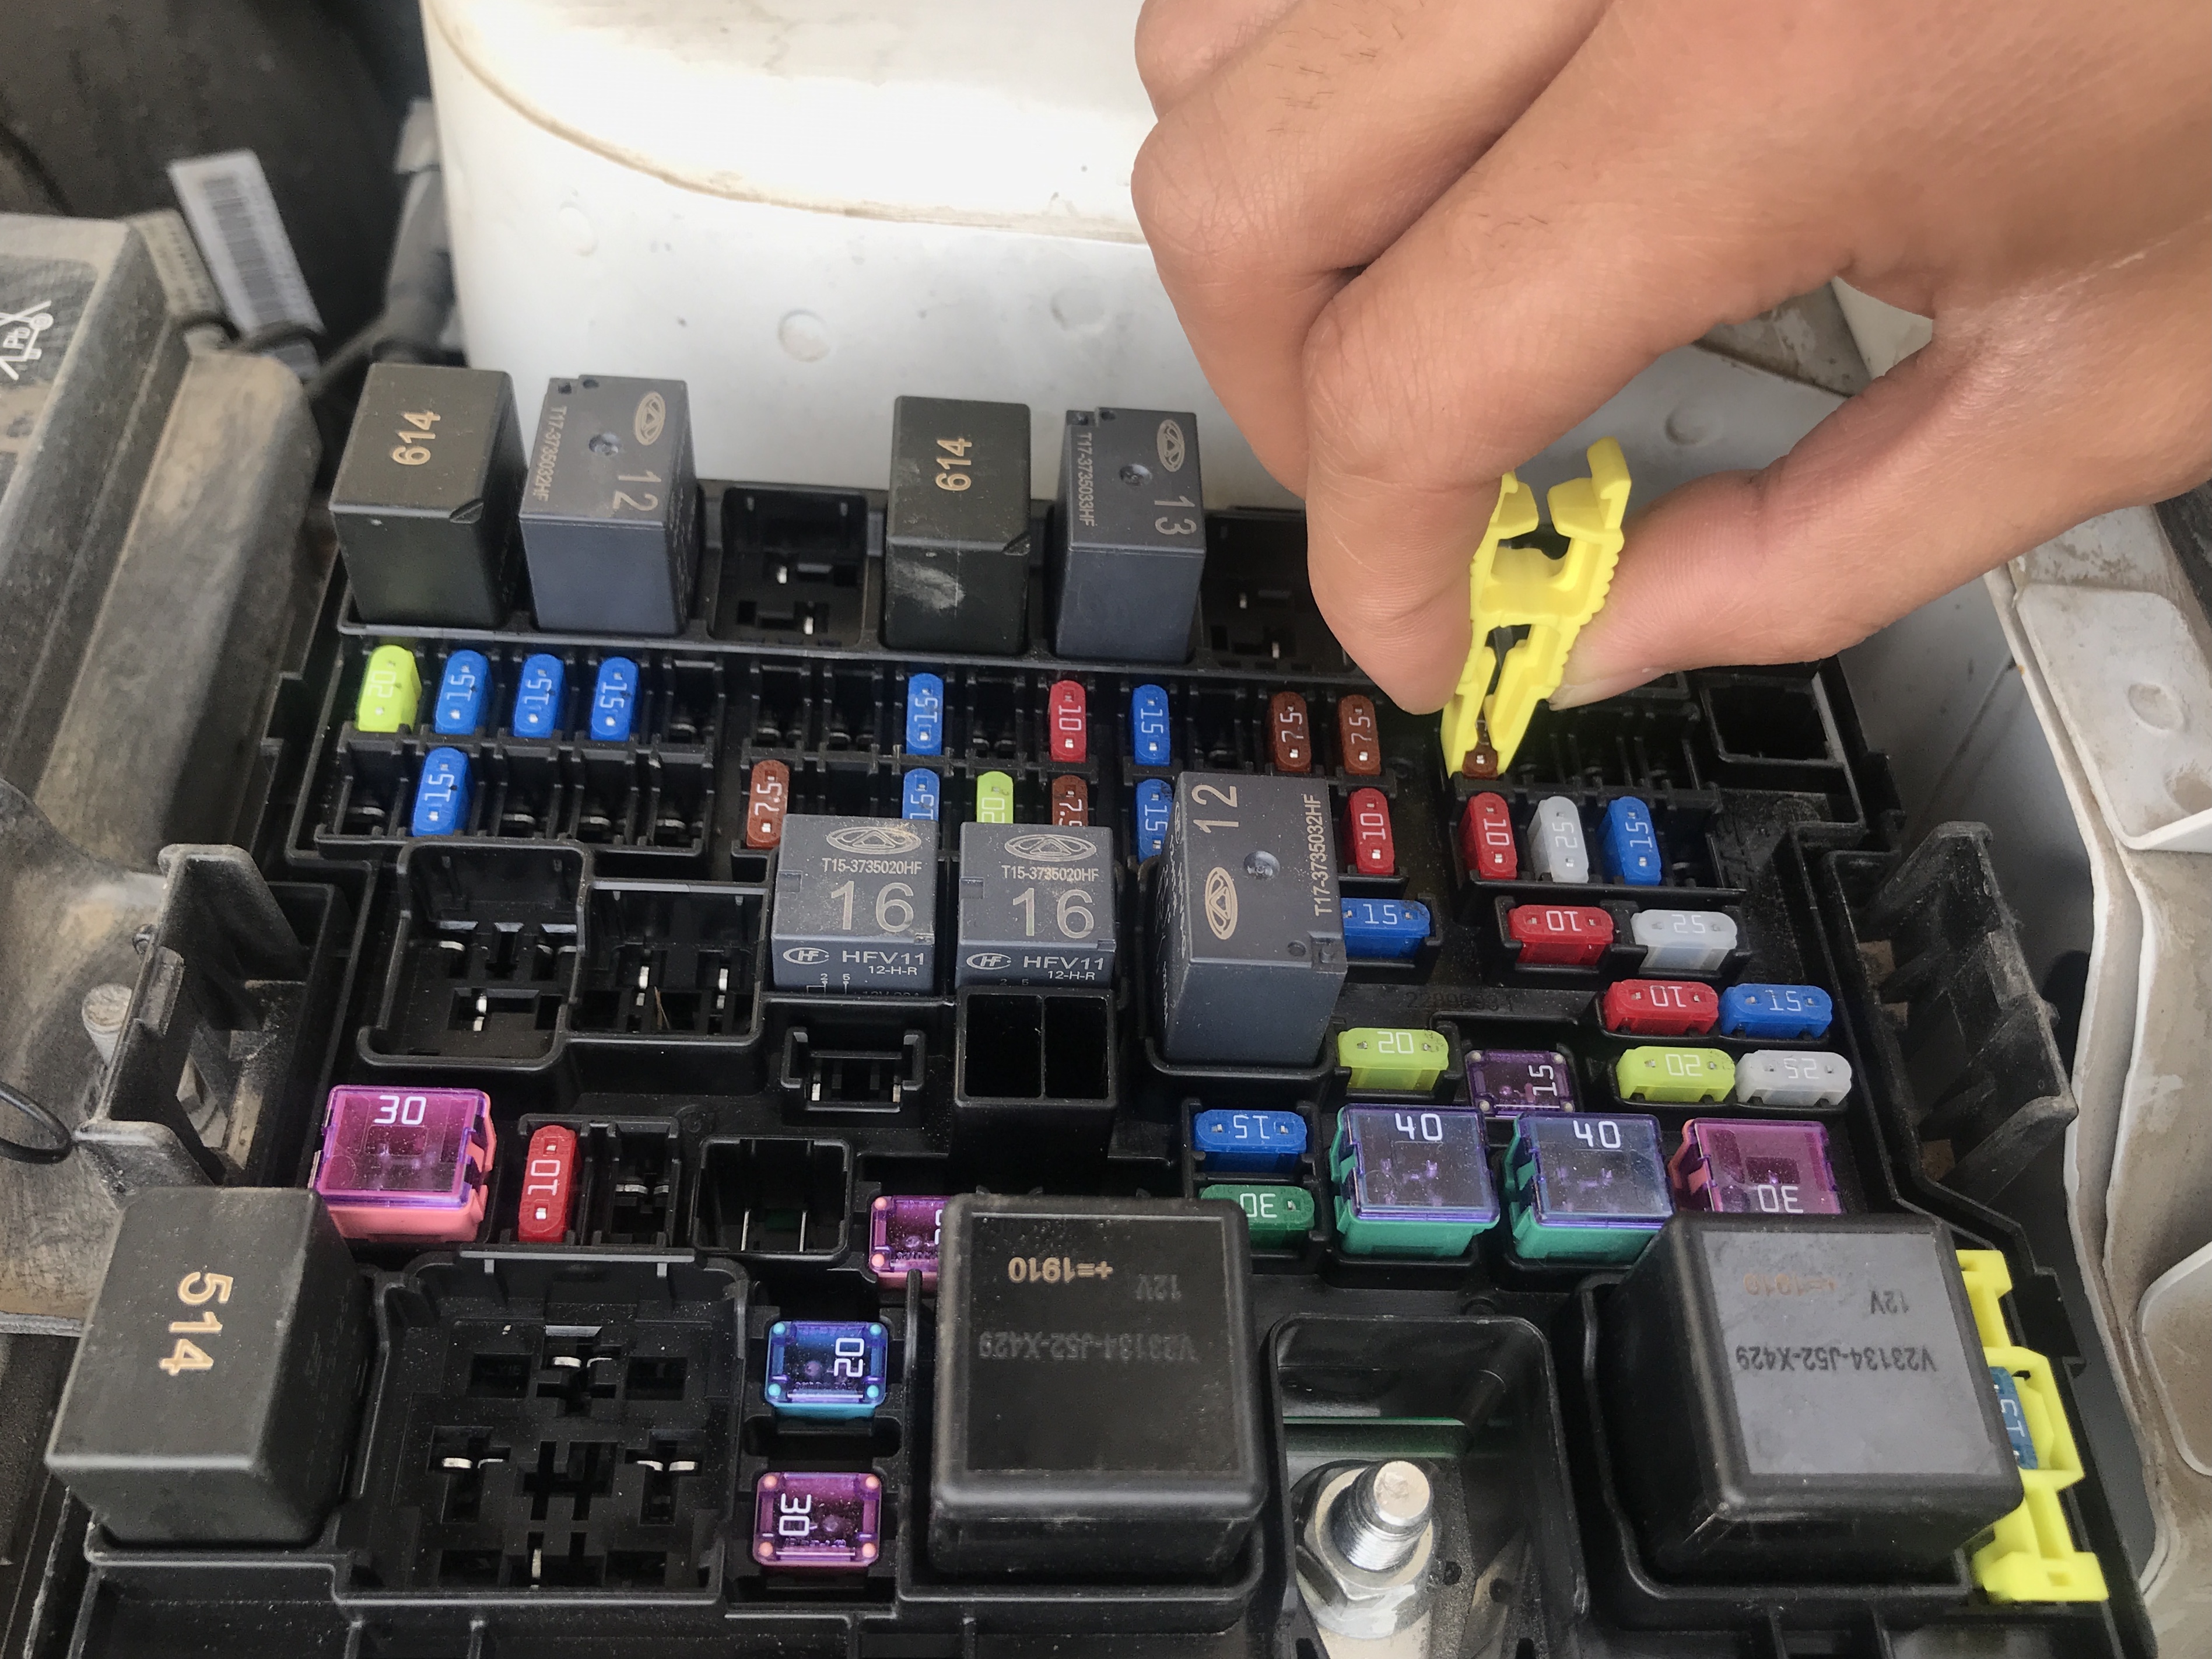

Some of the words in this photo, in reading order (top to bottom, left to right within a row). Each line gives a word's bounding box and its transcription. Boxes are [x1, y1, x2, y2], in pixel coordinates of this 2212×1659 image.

[390, 410, 441, 466] 614
[935, 437, 973, 491] 614
[612, 470, 662, 512] 12
[1076, 432, 1095, 527] T17-3735033HF
[1154, 495, 1197, 536] 13
[446, 674, 475, 701] 15
[524, 677, 553, 705] 15
[599, 681, 628, 709] 15
[914, 696, 938, 723] 15
[1058, 705, 1082, 731] 10
[1140, 708, 1164, 734] 15
[425, 773, 454, 802] 15
[1144, 804, 1169, 831] 15
[1191, 784, 1240, 834] 12
[1359, 813, 1387, 840] 10
[1482, 817, 1510, 846] 10
[1551, 821, 1578, 849] 25
[1625, 821, 1653, 849] 15
[822, 858, 922, 875] T15-3735020HF
[1303, 793, 1333, 917] T17-3735032HF
[1001, 863, 1099, 882] T15-3735020HF
[830, 880, 915, 933] 16
[1012, 887, 1095, 939] 16
[1362, 903, 1399, 926] 15
[1545, 909, 1583, 932] 10
[1671, 913, 1706, 935] 25
[842, 950, 924, 965] HFV11
[868, 965, 918, 976] 12-H-R
[1023, 956, 1105, 971] HFV11
[1047, 970, 1096, 981] 12-H-R
[1650, 985, 1687, 1008] 10
[1764, 989, 1803, 1012] 15
[1377, 1031, 1414, 1055] 20
[1665, 1054, 1703, 1077] 20
[1783, 1058, 1820, 1080] 25
[1528, 1065, 1558, 1097] 15
[374, 1094, 427, 1126] 30
[1233, 1114, 1270, 1139] 15
[1395, 1112, 1443, 1142] 40
[1573, 1119, 1622, 1149] 40
[527, 1159, 561, 1196] 10
[1239, 1193, 1278, 1218] 30
[1757, 1184, 1804, 1214] 30
[1135, 1273, 1182, 1301] 12V
[1869, 1289, 1910, 1316] 12V
[158, 1270, 234, 1377] 514
[834, 1338, 865, 1377] 20
[779, 1493, 812, 1536] 30
